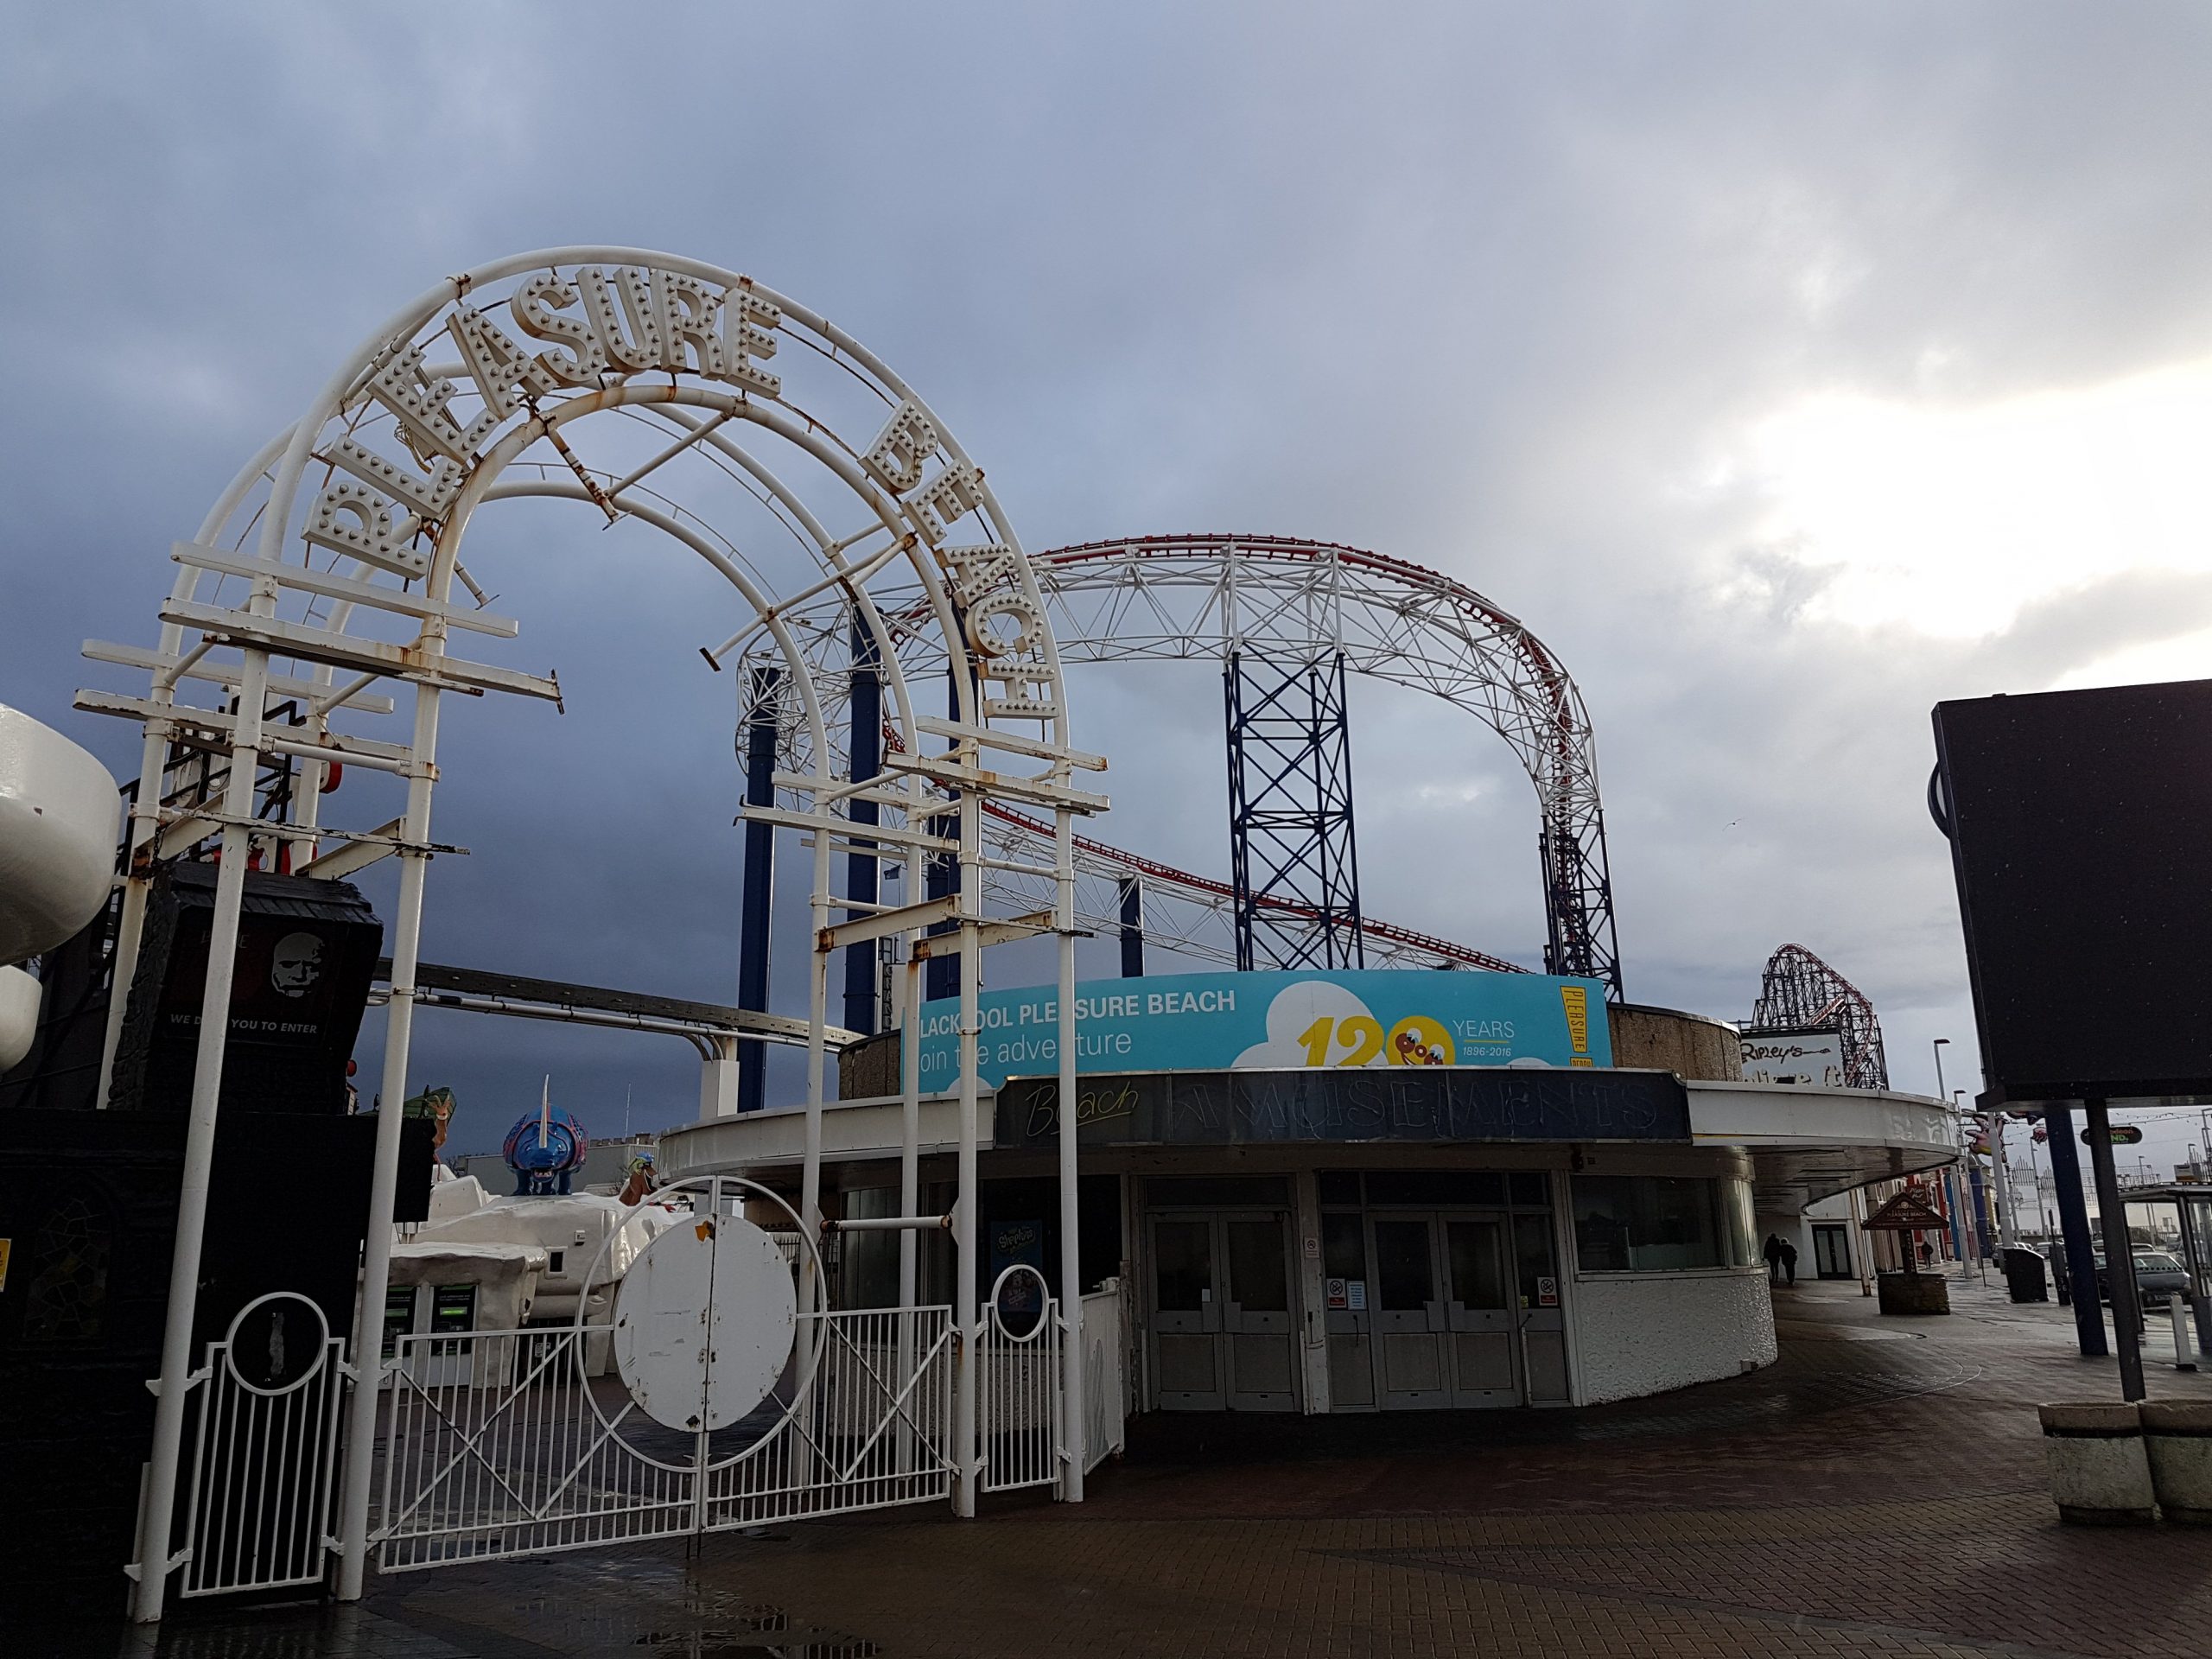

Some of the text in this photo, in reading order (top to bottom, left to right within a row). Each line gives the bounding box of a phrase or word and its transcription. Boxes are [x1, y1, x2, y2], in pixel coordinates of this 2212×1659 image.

[301, 266, 1059, 720] PLEASURE BEACH
[170, 1014, 192, 1025] WE
[231, 1019, 257, 1029] YOU
[261, 1021, 276, 1031] TO
[280, 1023, 318, 1034] ENTER
[920, 989, 1235, 1038] LACKOOL PLESURE BEACH
[1452, 1020, 1514, 1039] YEARS
[1564, 990, 1585, 1049] PLEASURE
[920, 1032, 1132, 1072] oin te adveture
[1463, 1046, 1512, 1057] 1896-2016
